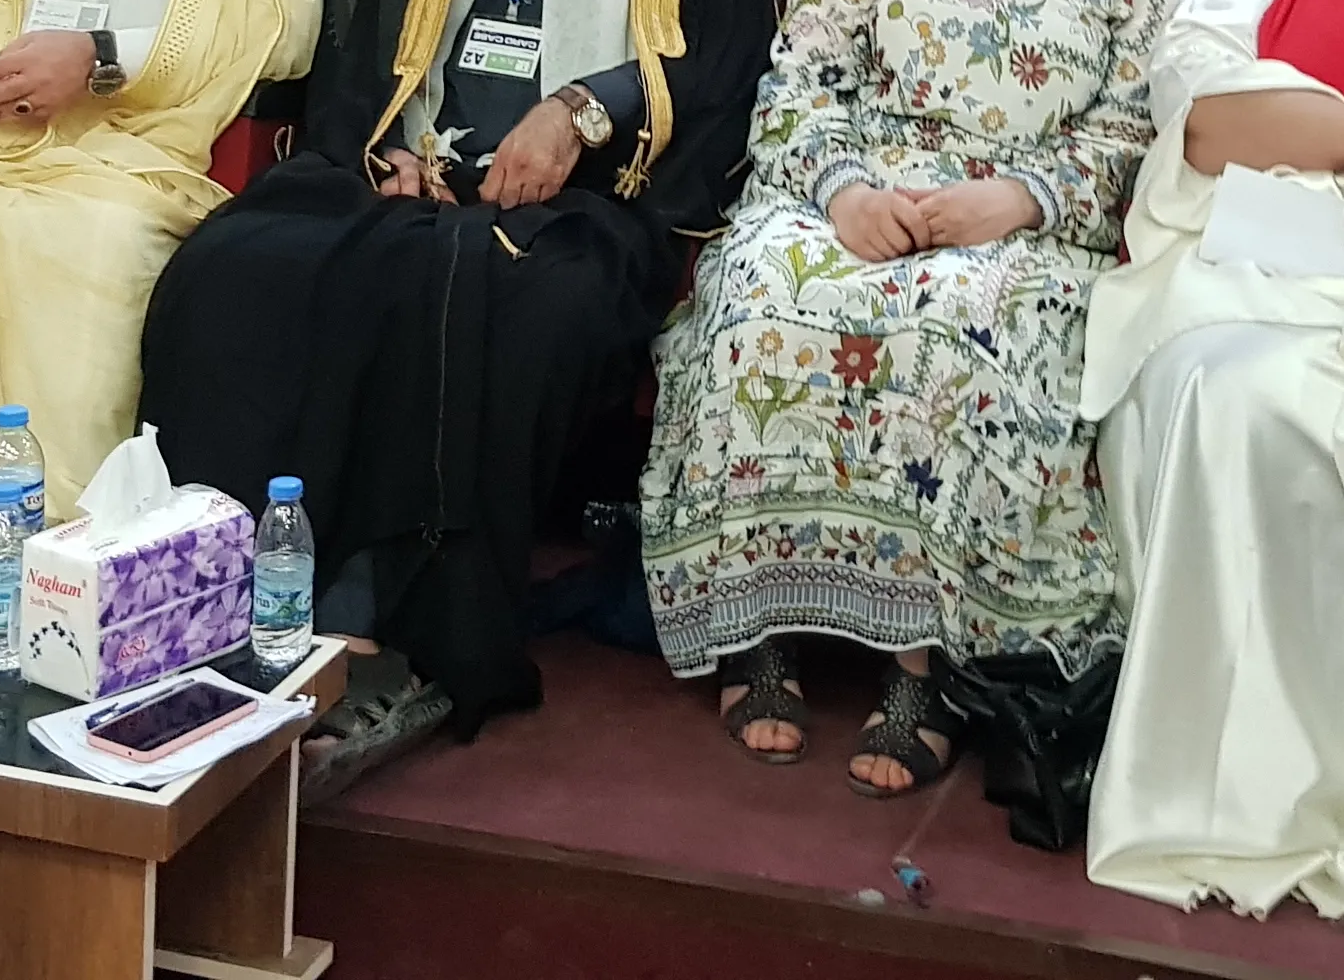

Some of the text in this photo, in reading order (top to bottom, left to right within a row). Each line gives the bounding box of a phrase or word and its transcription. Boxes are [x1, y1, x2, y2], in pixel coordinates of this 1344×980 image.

[505, 36, 537, 49] CARD
[463, 51, 485, 65] A2
[26, 568, 82, 598] Nagham
